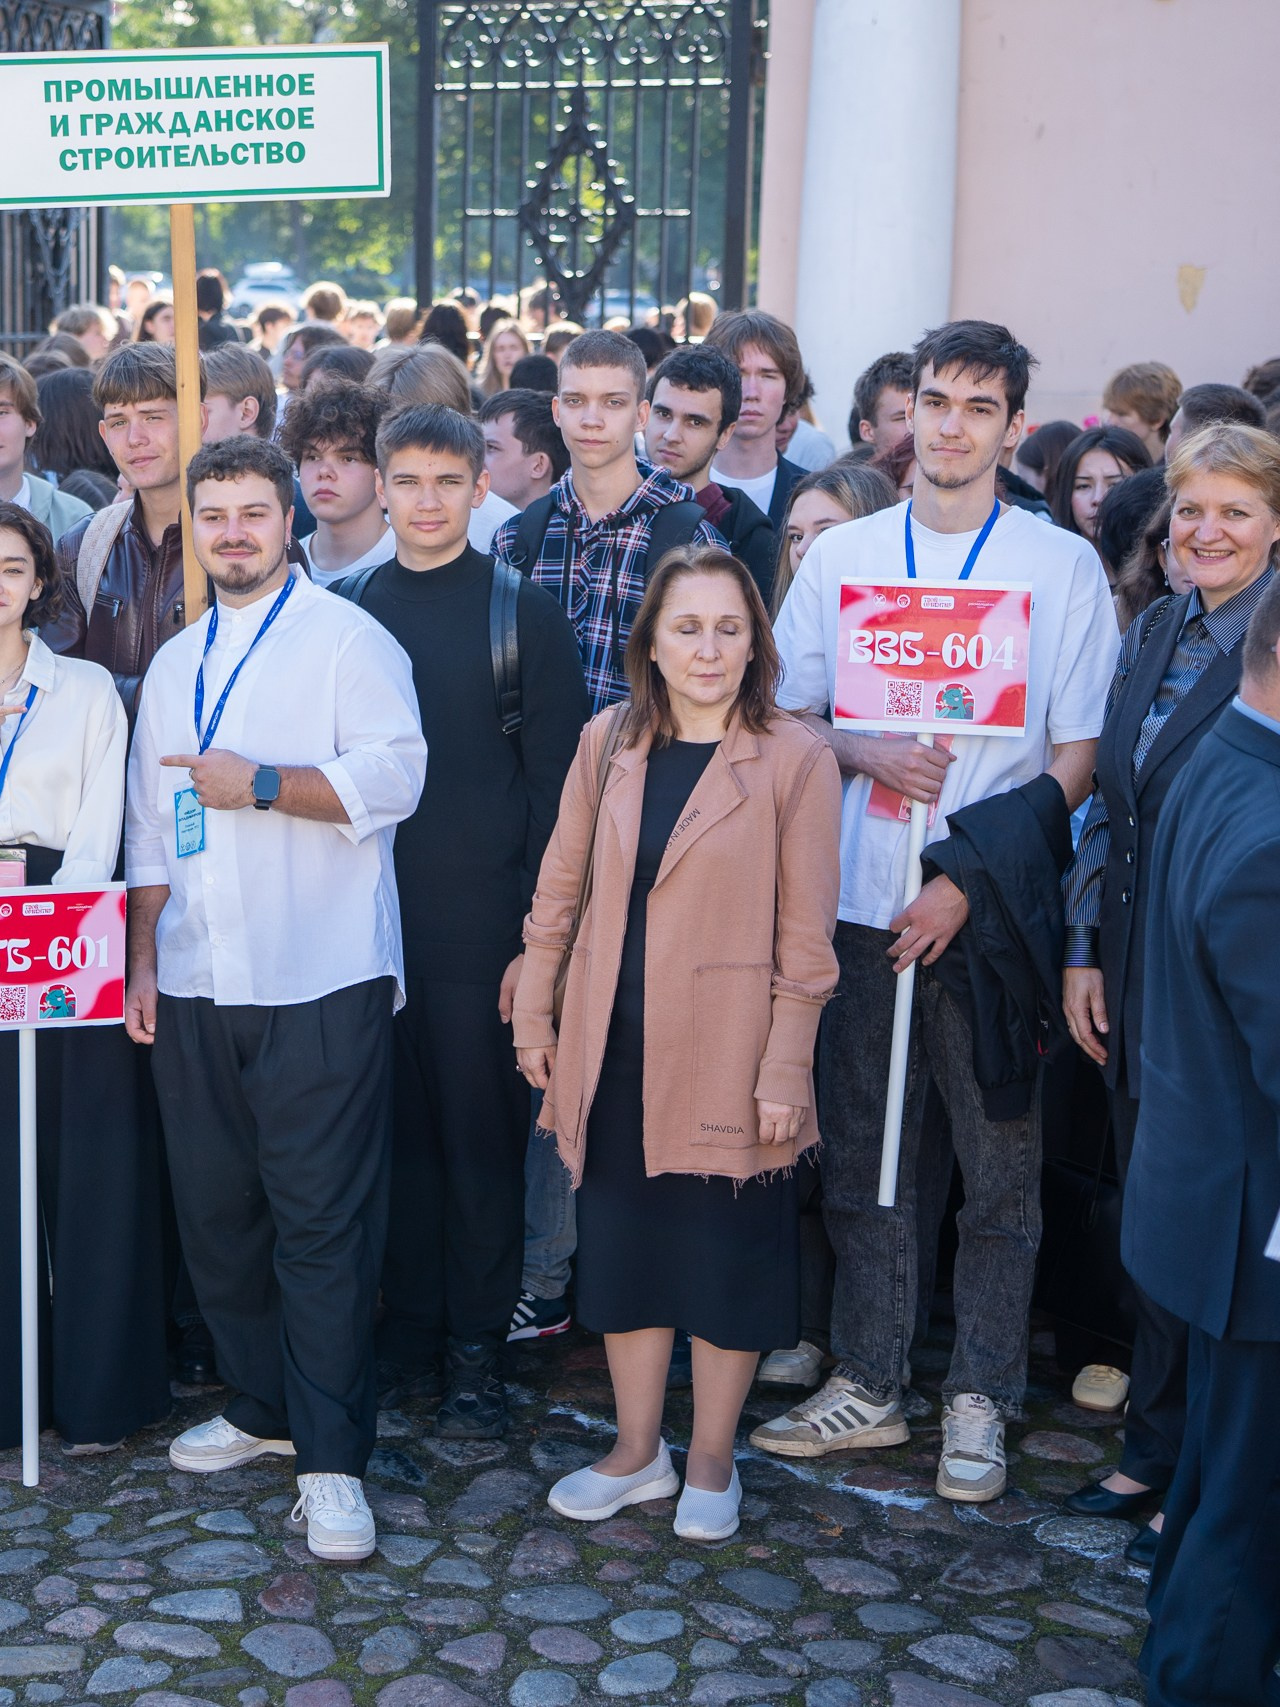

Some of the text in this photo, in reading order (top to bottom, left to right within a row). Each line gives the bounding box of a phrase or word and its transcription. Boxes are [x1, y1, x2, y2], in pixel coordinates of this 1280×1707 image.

[43, 73, 315, 103] ПРОМЫШЛЕННОЕ
[50, 106, 315, 138] И ГРАЖДАНСКОЕ
[58, 140, 306, 171] СТРОИТЕЛЬСТВО
[848, 629, 1018, 670] ВВБ-604
[678, 808, 701, 832] MADE
[700, 1123, 745, 1134] SHAVDIA
